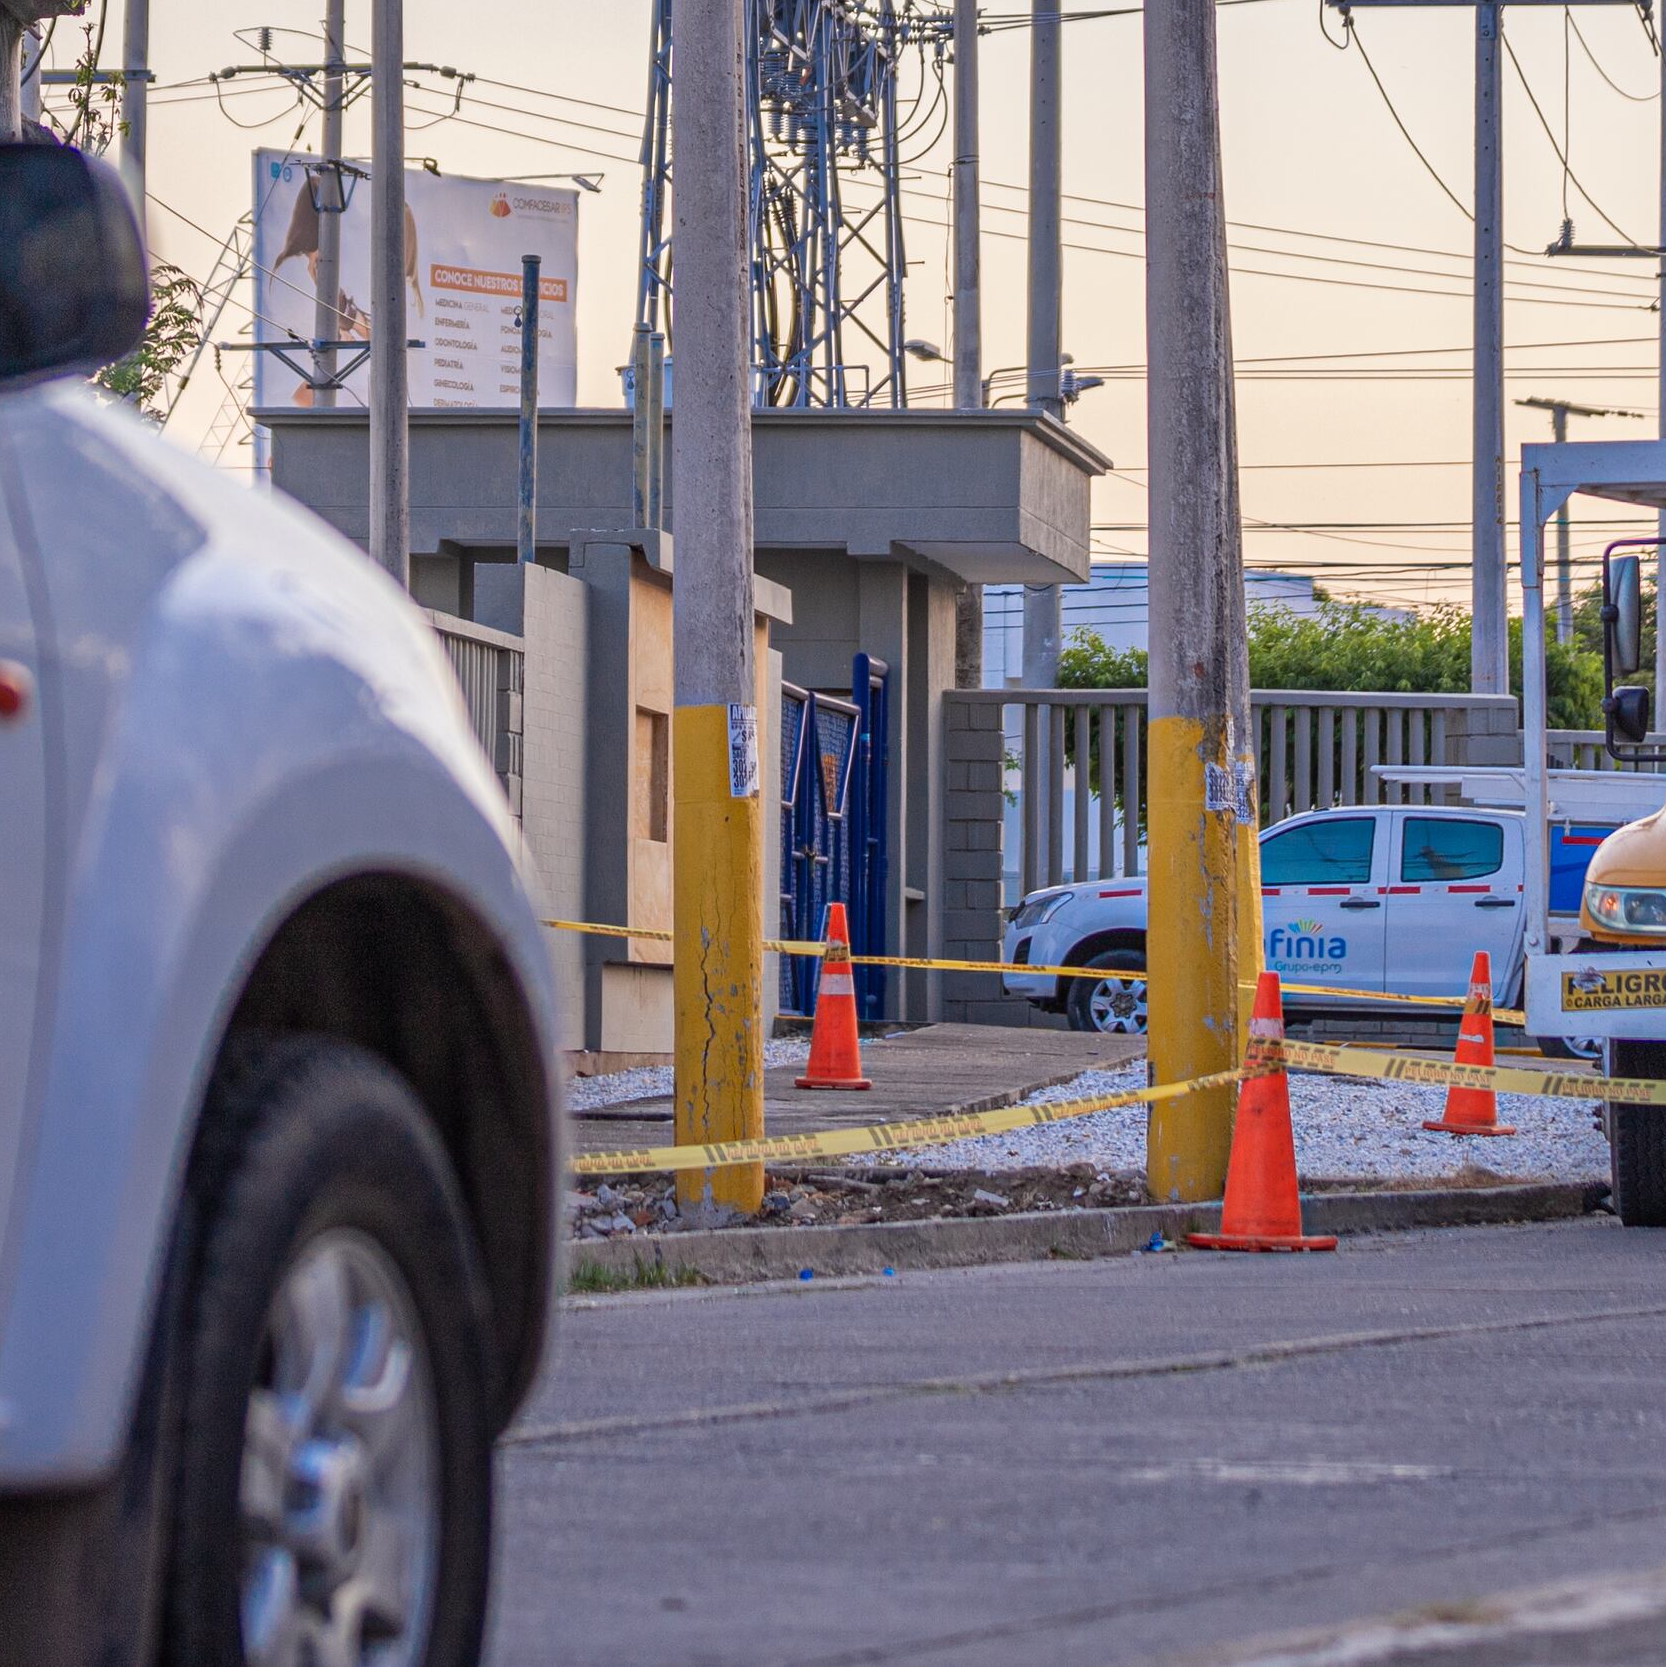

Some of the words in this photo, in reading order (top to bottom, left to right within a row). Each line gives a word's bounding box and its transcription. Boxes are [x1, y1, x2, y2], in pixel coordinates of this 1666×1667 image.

[434, 269, 472, 285] CONOCE
[474, 274, 518, 292] NUESTROS
[1264, 928, 1347, 959] finia
[1574, 995, 1622, 1008] CARGA
[1310, 1052, 1336, 1065] PASE
[1404, 1066, 1447, 1080] PELIGRO
[1466, 1073, 1493, 1085] PASE
[1561, 1082, 1606, 1097] PELIGRO
